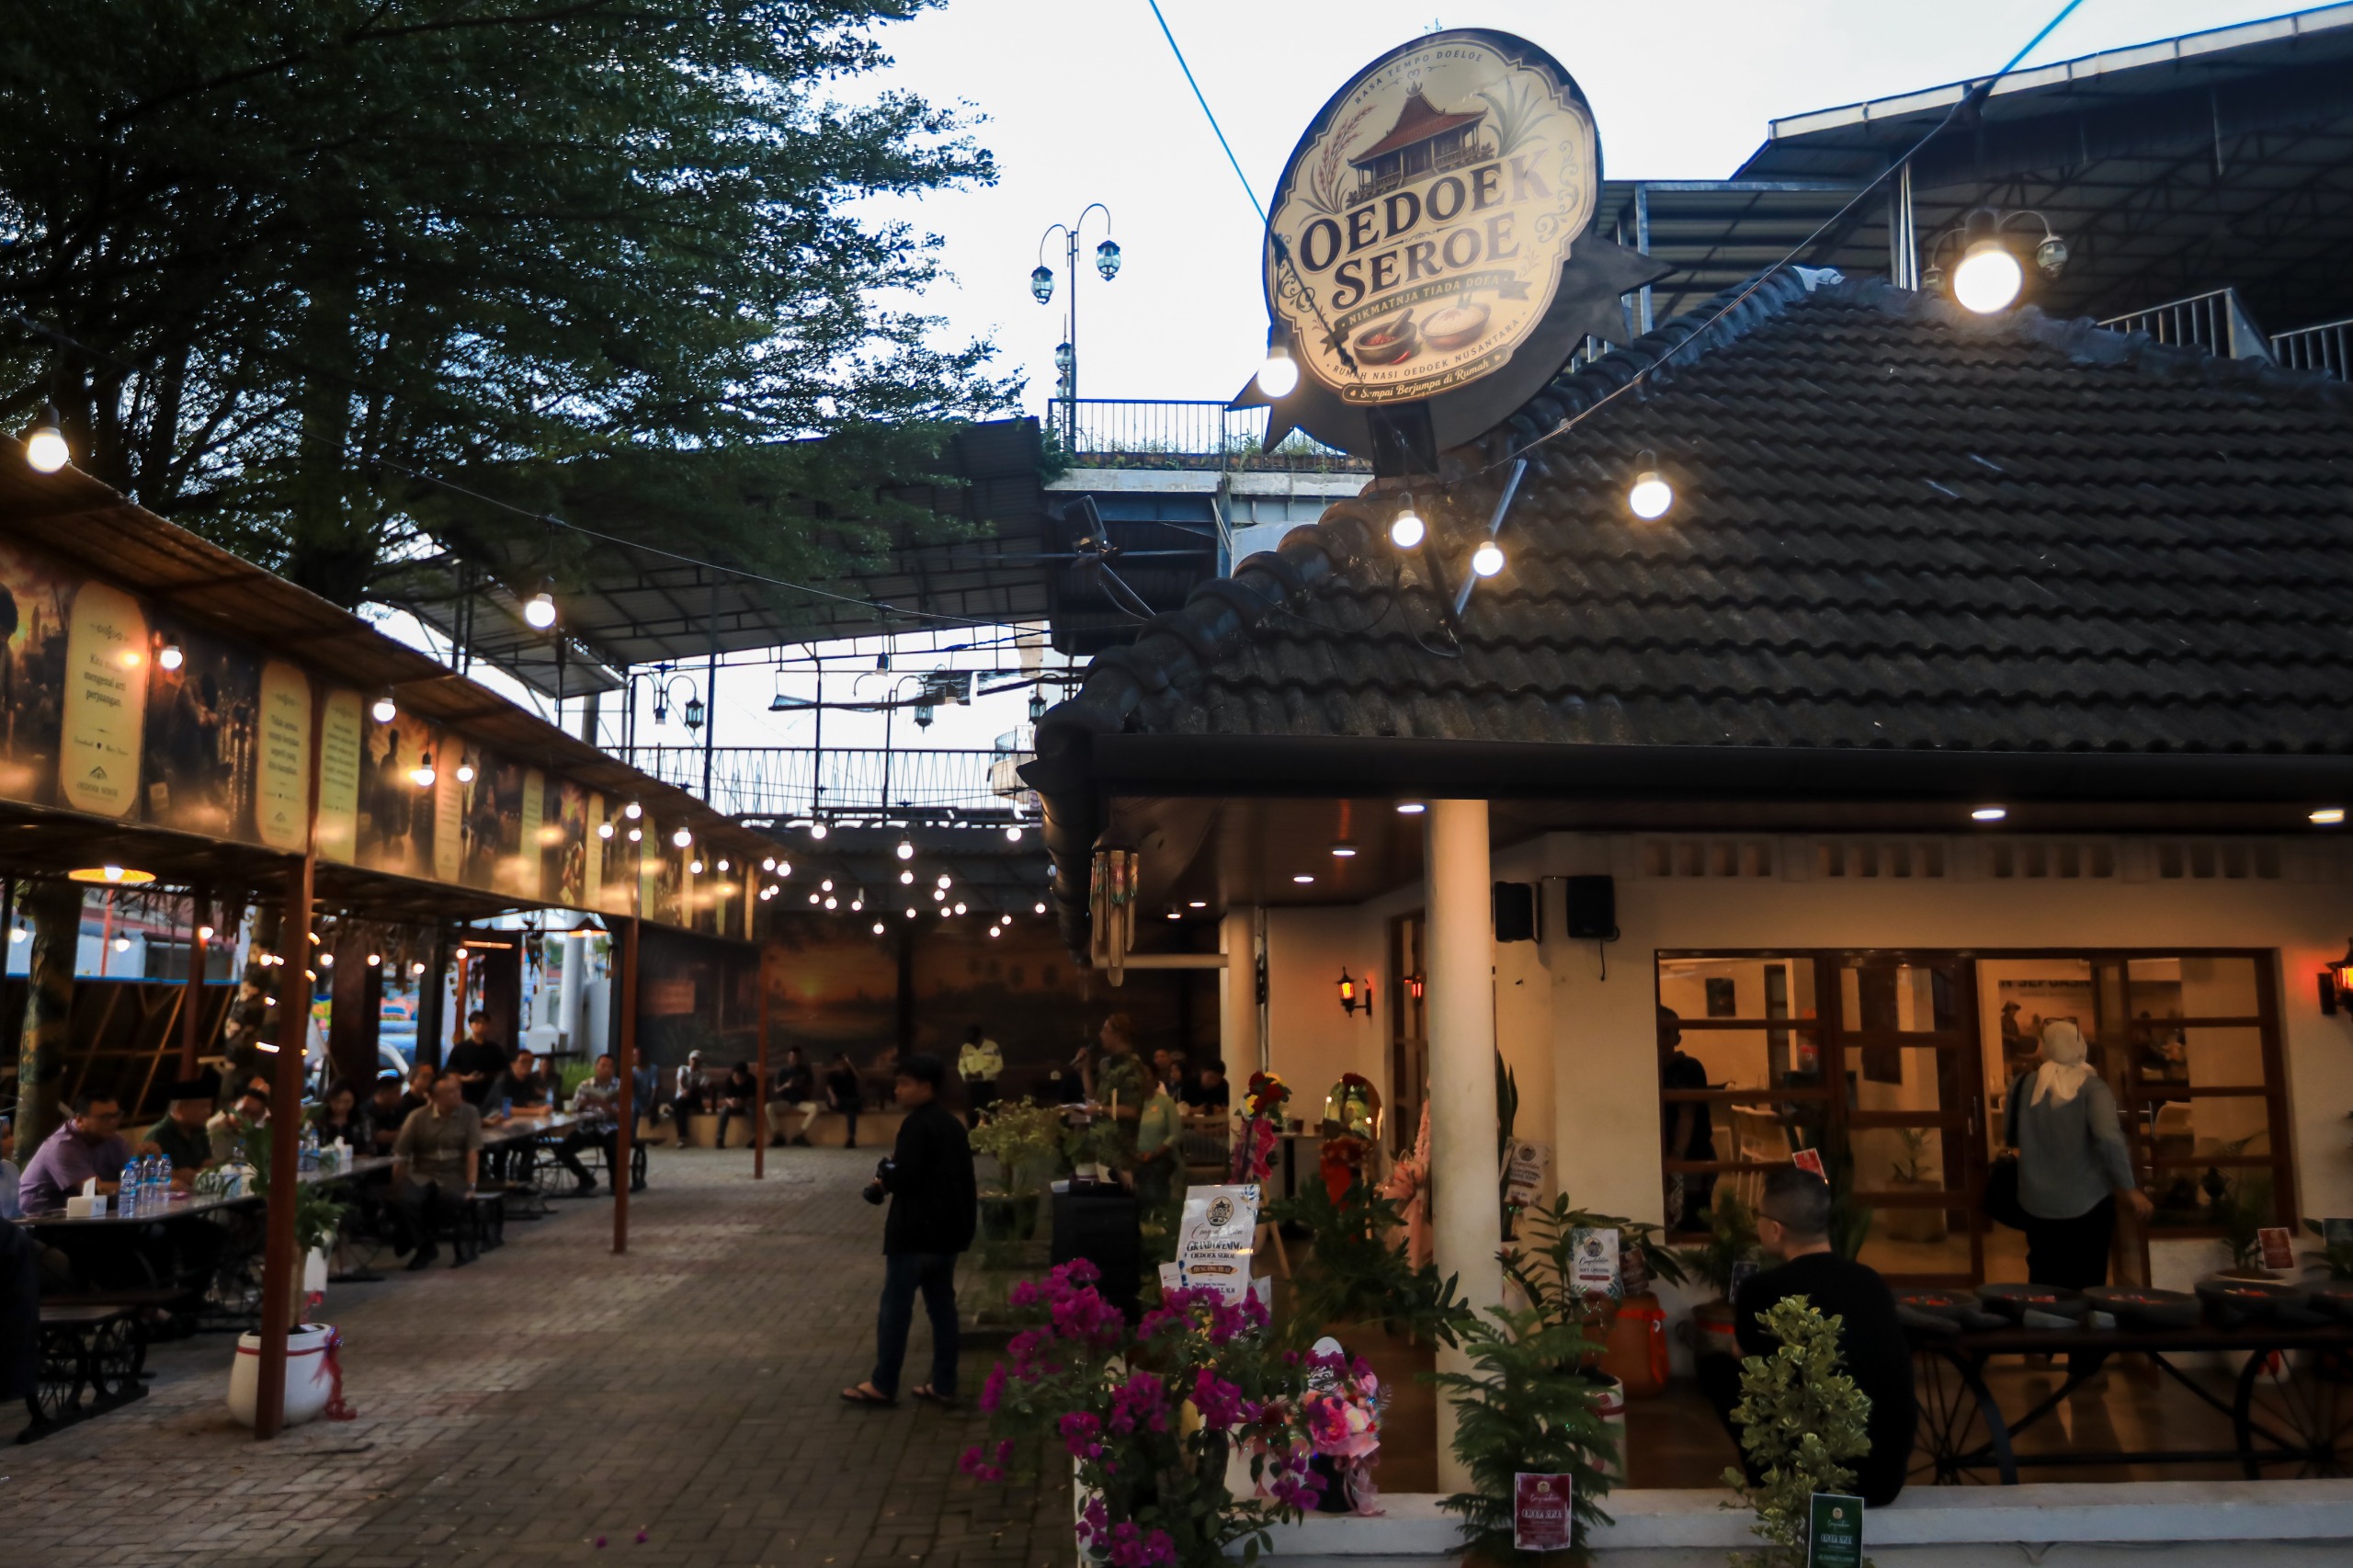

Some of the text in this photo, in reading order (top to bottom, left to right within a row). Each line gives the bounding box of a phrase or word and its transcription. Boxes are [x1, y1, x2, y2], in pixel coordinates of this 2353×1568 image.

[1355, 50, 1483, 104] RASA TEMPO DOELOE
[1300, 148, 1553, 273] OEDOEK
[1331, 211, 1520, 311] SEROE
[1348, 275, 1499, 325] NIKMATNJA TIADA DOEA
[1372, 370, 1398, 381] NASI
[1404, 359, 1449, 377] OEDOEK
[1455, 319, 1518, 363] NUSANTARA
[1360, 358, 1489, 400] Smpai Berjumpa di Rumah
[1187, 1240, 1212, 1251] GRAND
